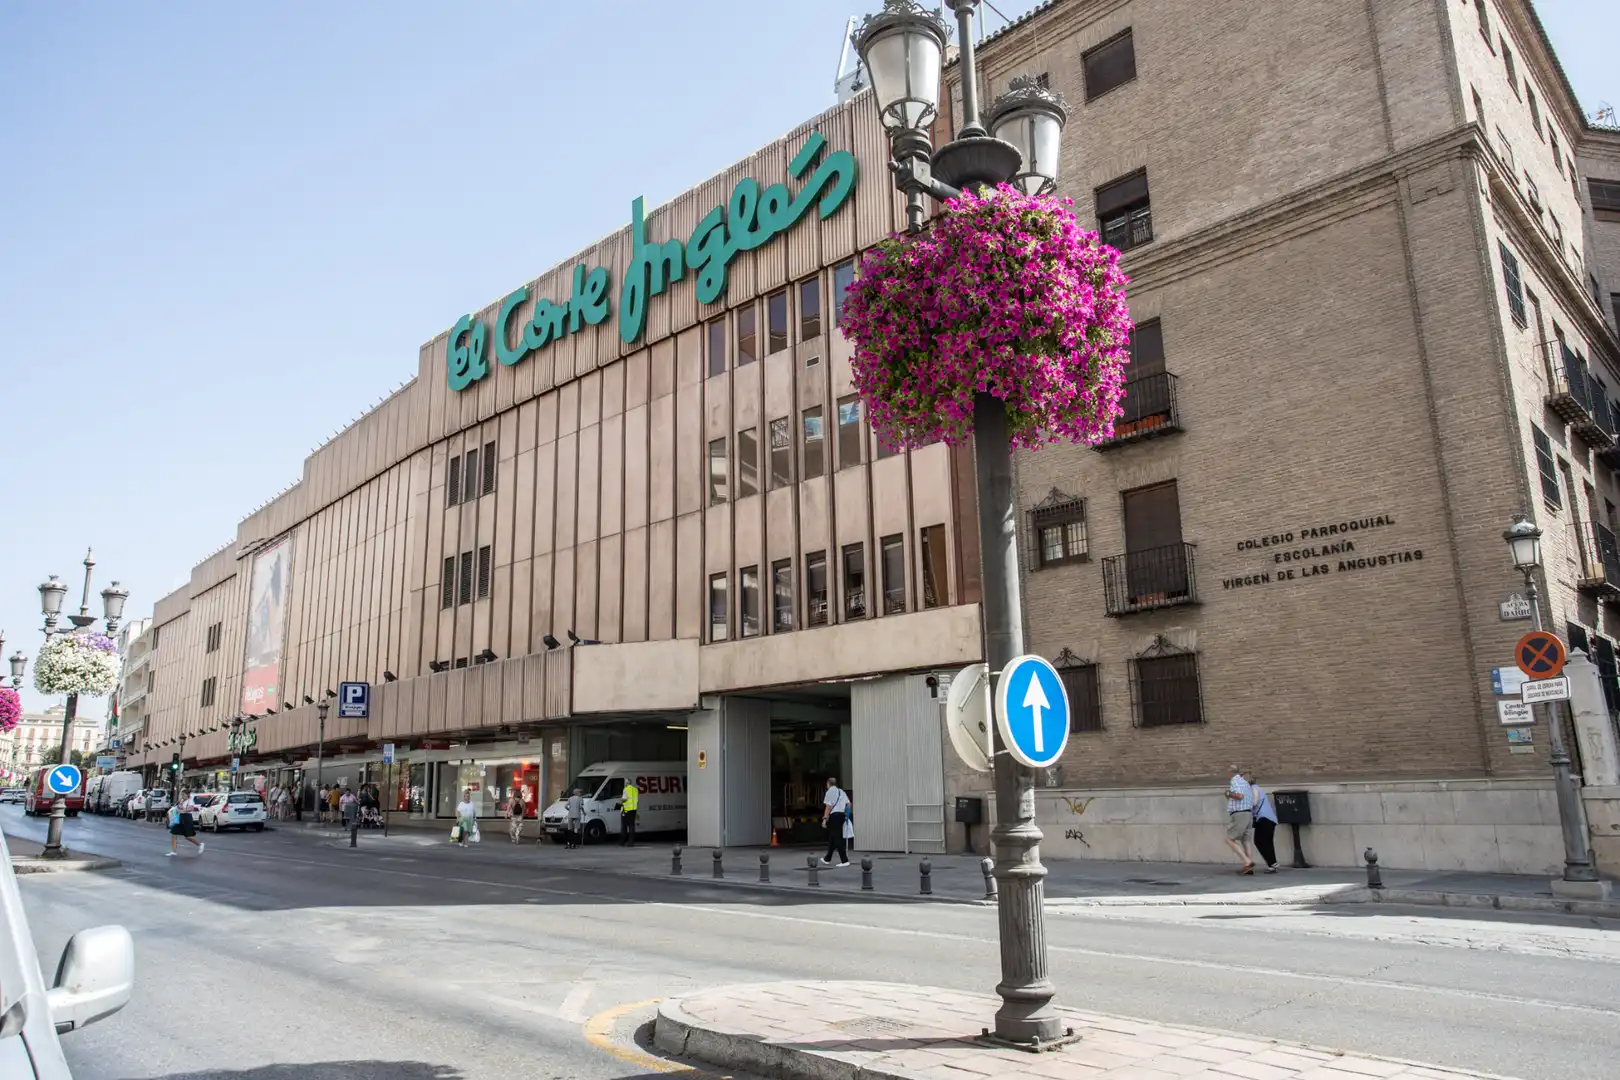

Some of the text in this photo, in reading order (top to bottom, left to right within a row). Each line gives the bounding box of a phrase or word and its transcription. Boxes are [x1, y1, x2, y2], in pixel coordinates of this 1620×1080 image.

[447, 130, 860, 391] El Corte Inglés
[1236, 514, 1395, 552] COLEGIO PARROQUIAL
[1274, 539, 1355, 564] ESCOLANÍA
[1222, 549, 1424, 590] VIRGEN DE LAS ANGUSTIAS
[347, 686, 363, 704] P
[1503, 709, 1529, 717] Bilingüe
[635, 775, 681, 795] SEUR
